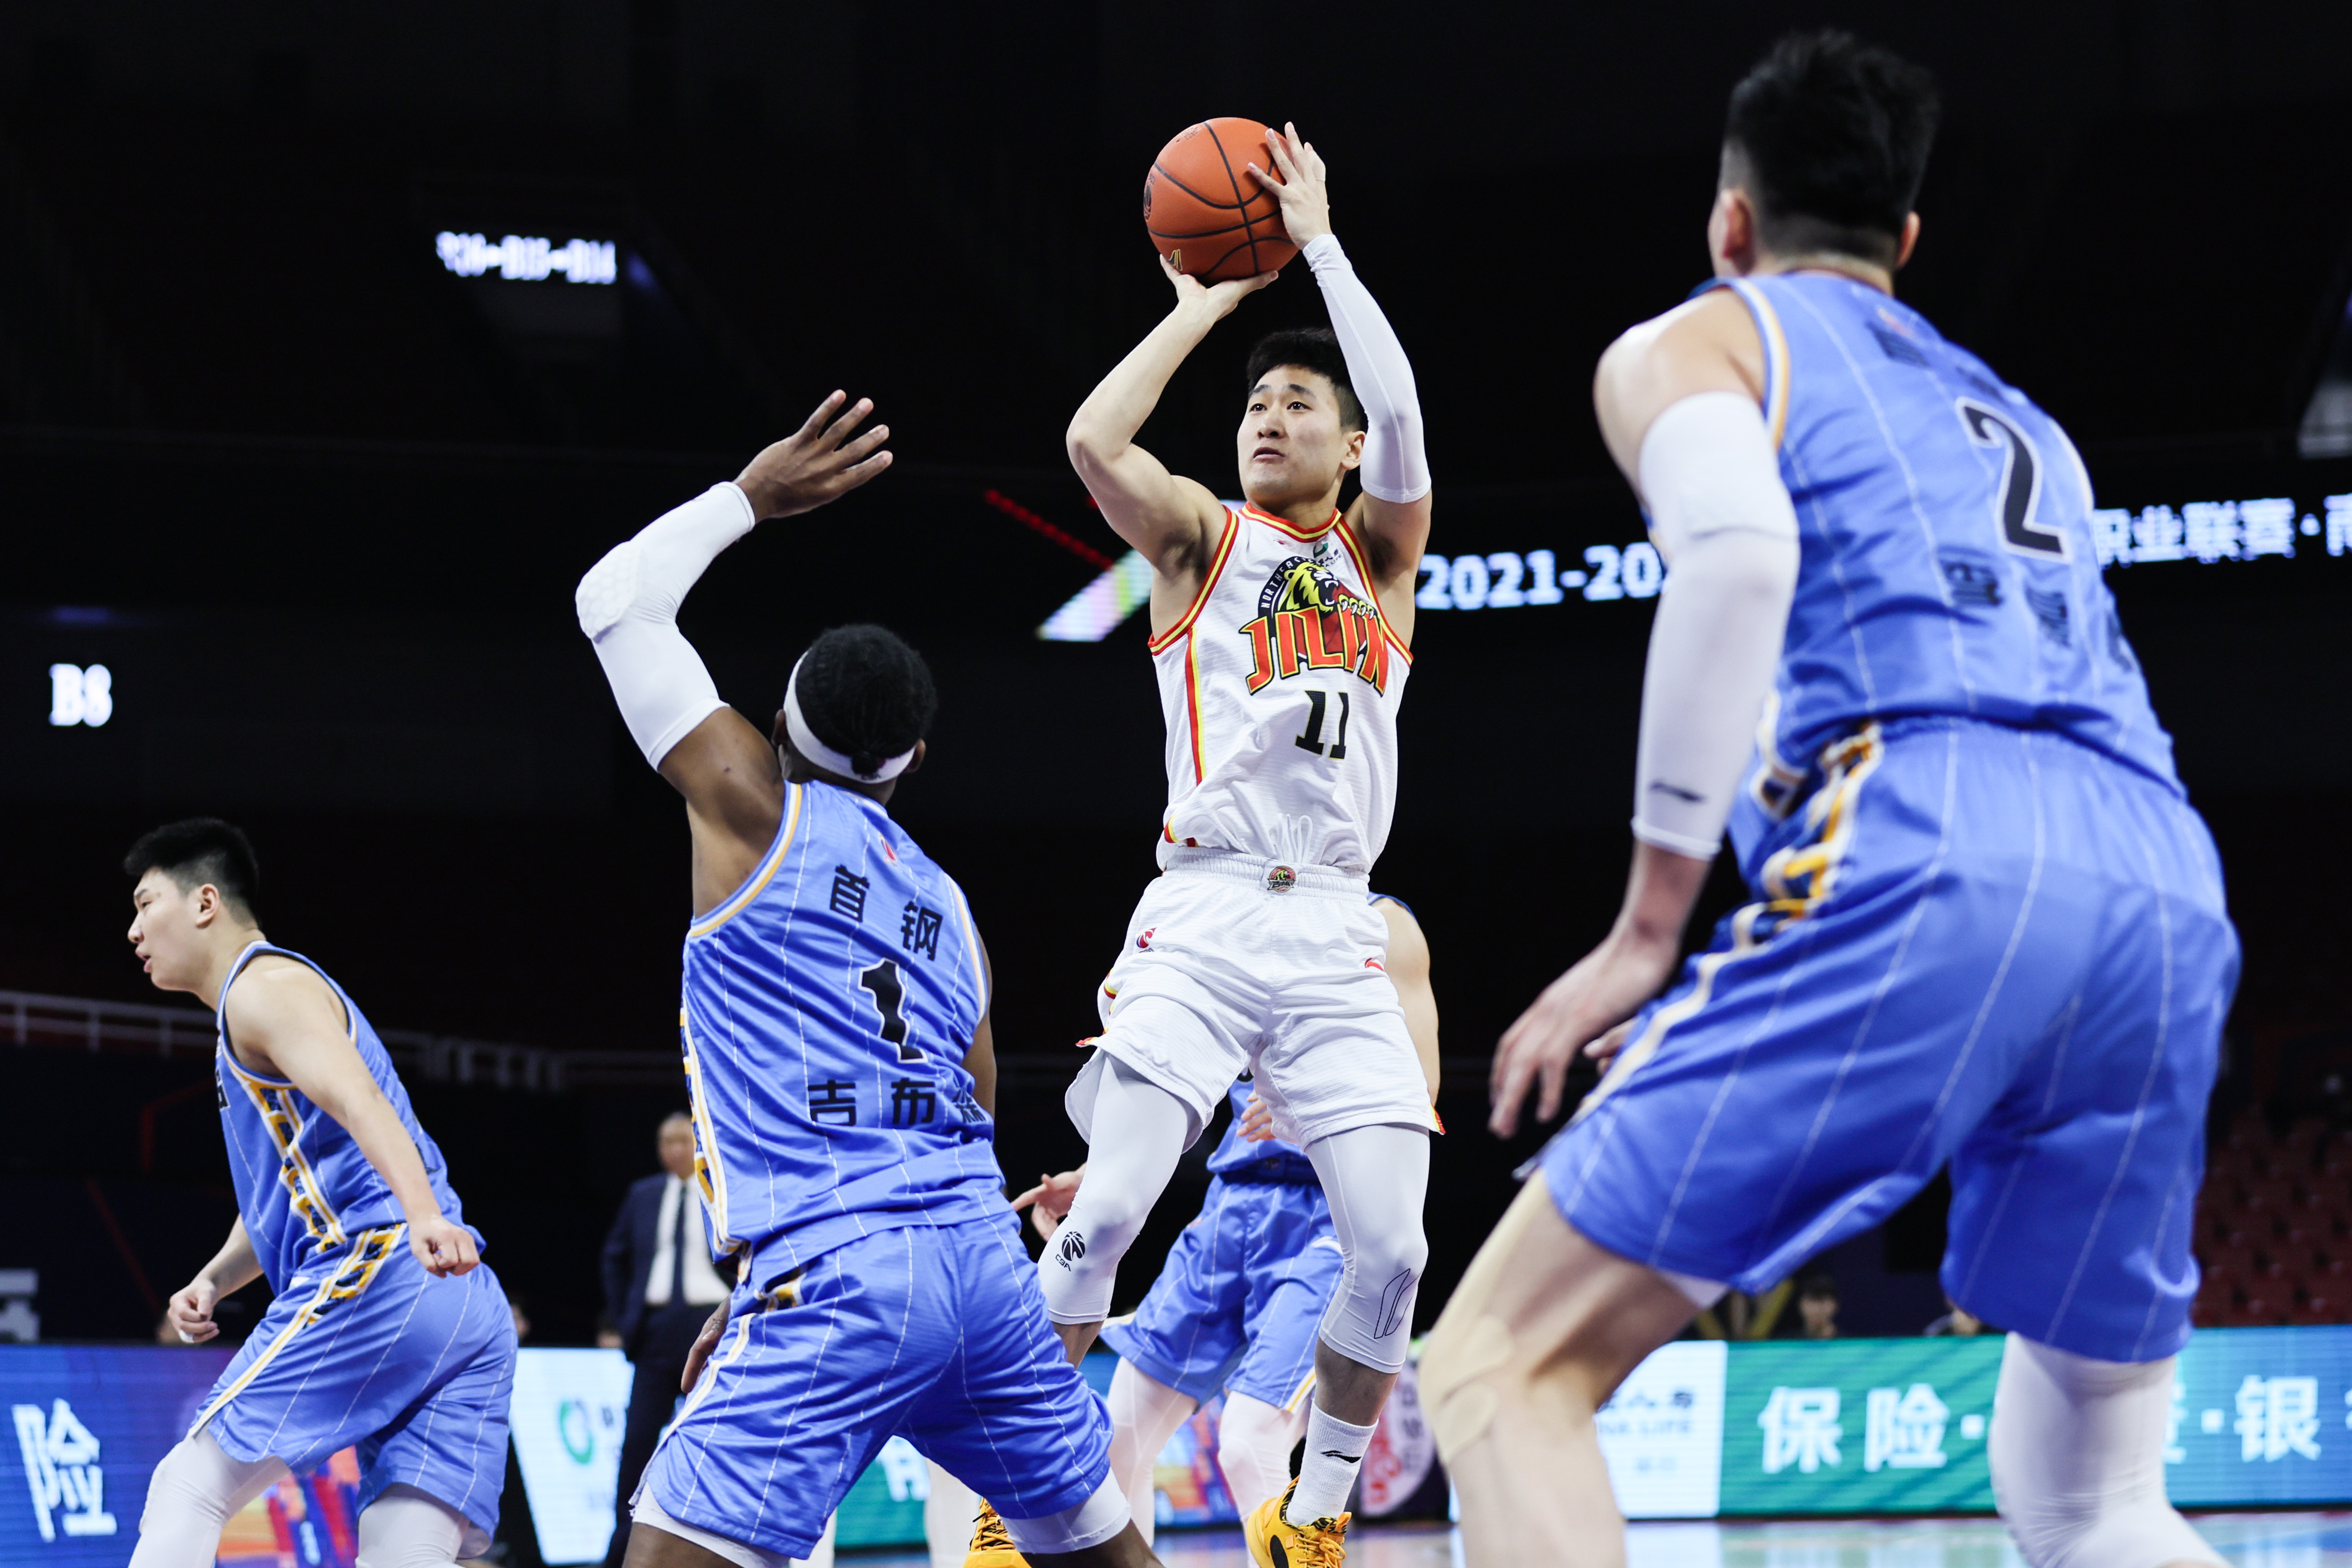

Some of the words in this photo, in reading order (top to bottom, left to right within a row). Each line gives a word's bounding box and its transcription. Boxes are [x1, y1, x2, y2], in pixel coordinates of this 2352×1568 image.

[1955, 397, 2074, 565] 2
[1239, 603, 1390, 697] JILIN
[1295, 690, 1349, 760] 11
[830, 865, 943, 961] 首钢
[858, 957, 929, 1064] 1
[1055, 1254, 1072, 1272] CBA
[11, 1398, 118, 1543] 险
